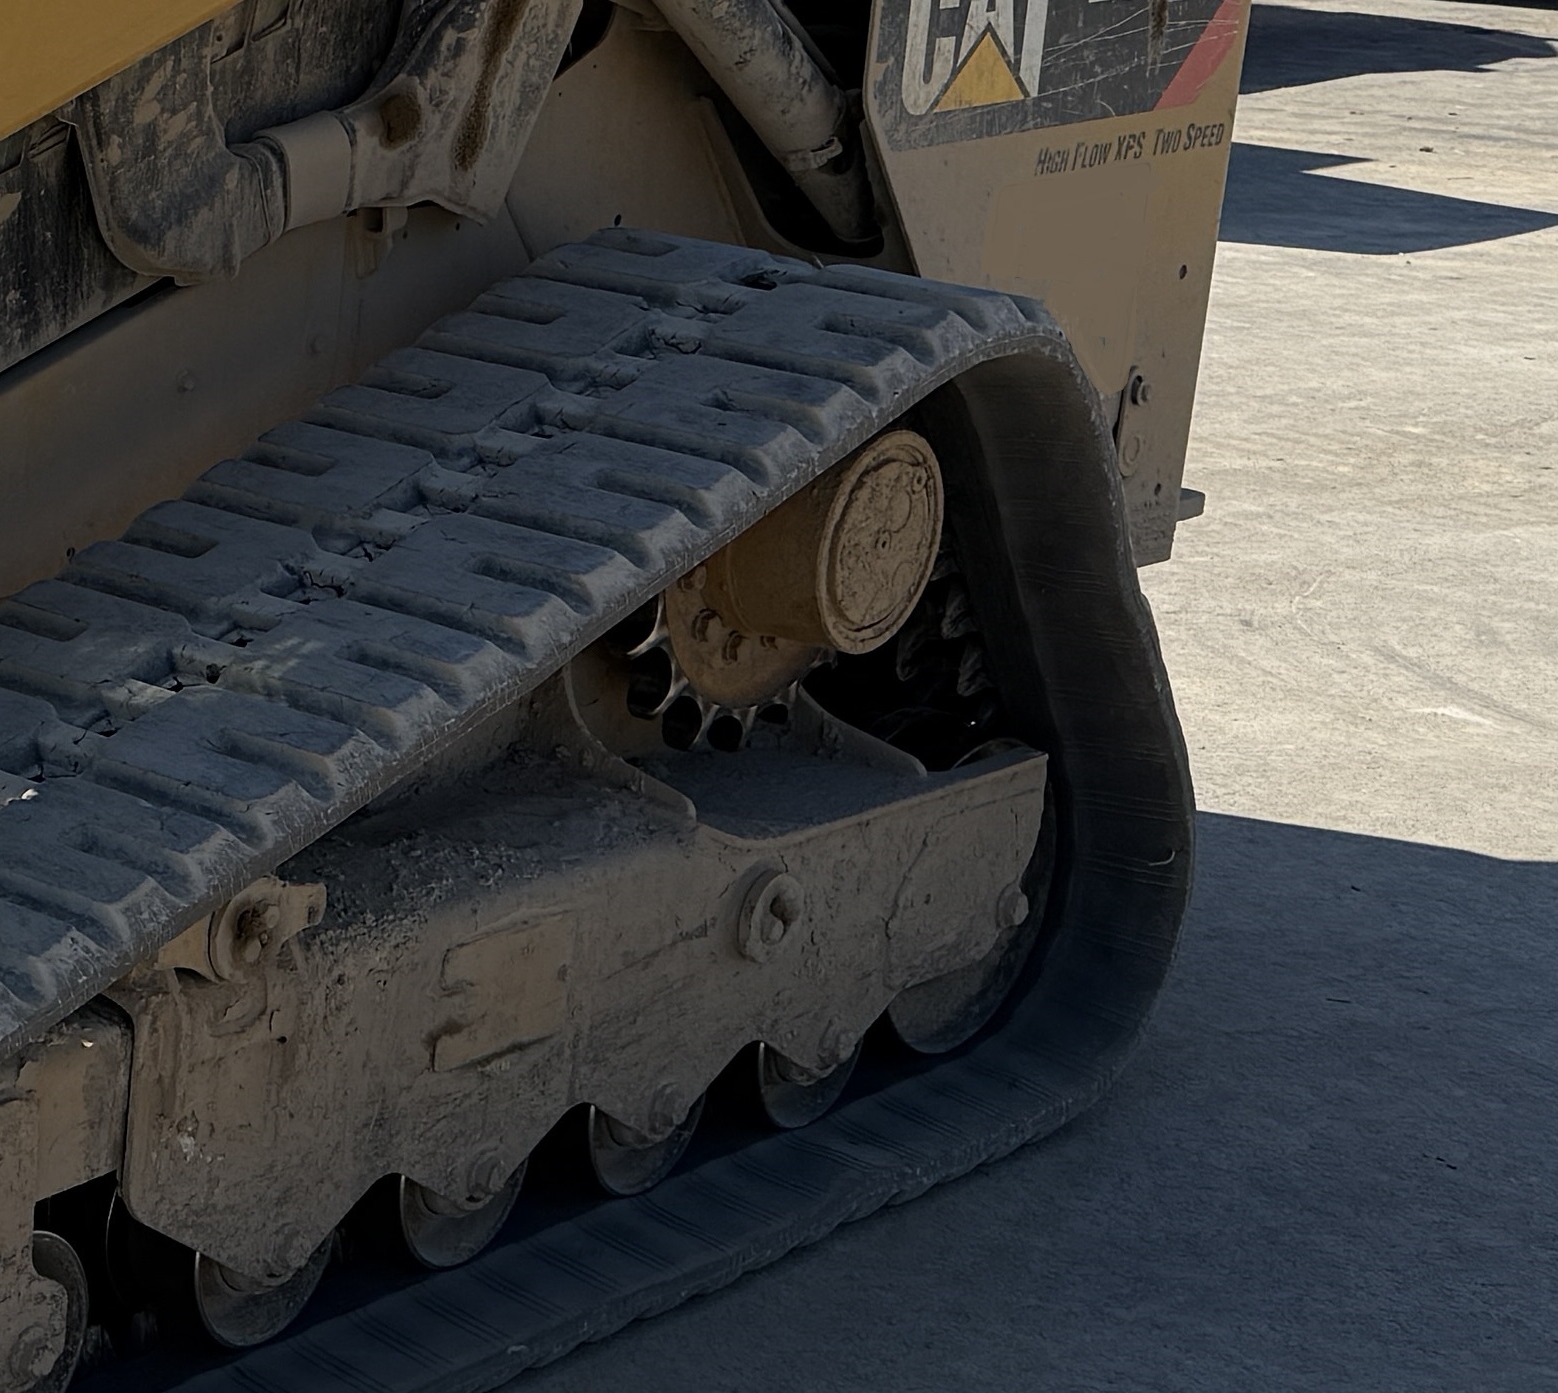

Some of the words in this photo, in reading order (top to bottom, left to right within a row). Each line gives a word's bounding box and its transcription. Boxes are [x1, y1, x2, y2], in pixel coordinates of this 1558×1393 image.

[1071, 141, 1112, 171] FLOW
[1153, 128, 1182, 156] TWO
[1183, 123, 1225, 151] SPEED
